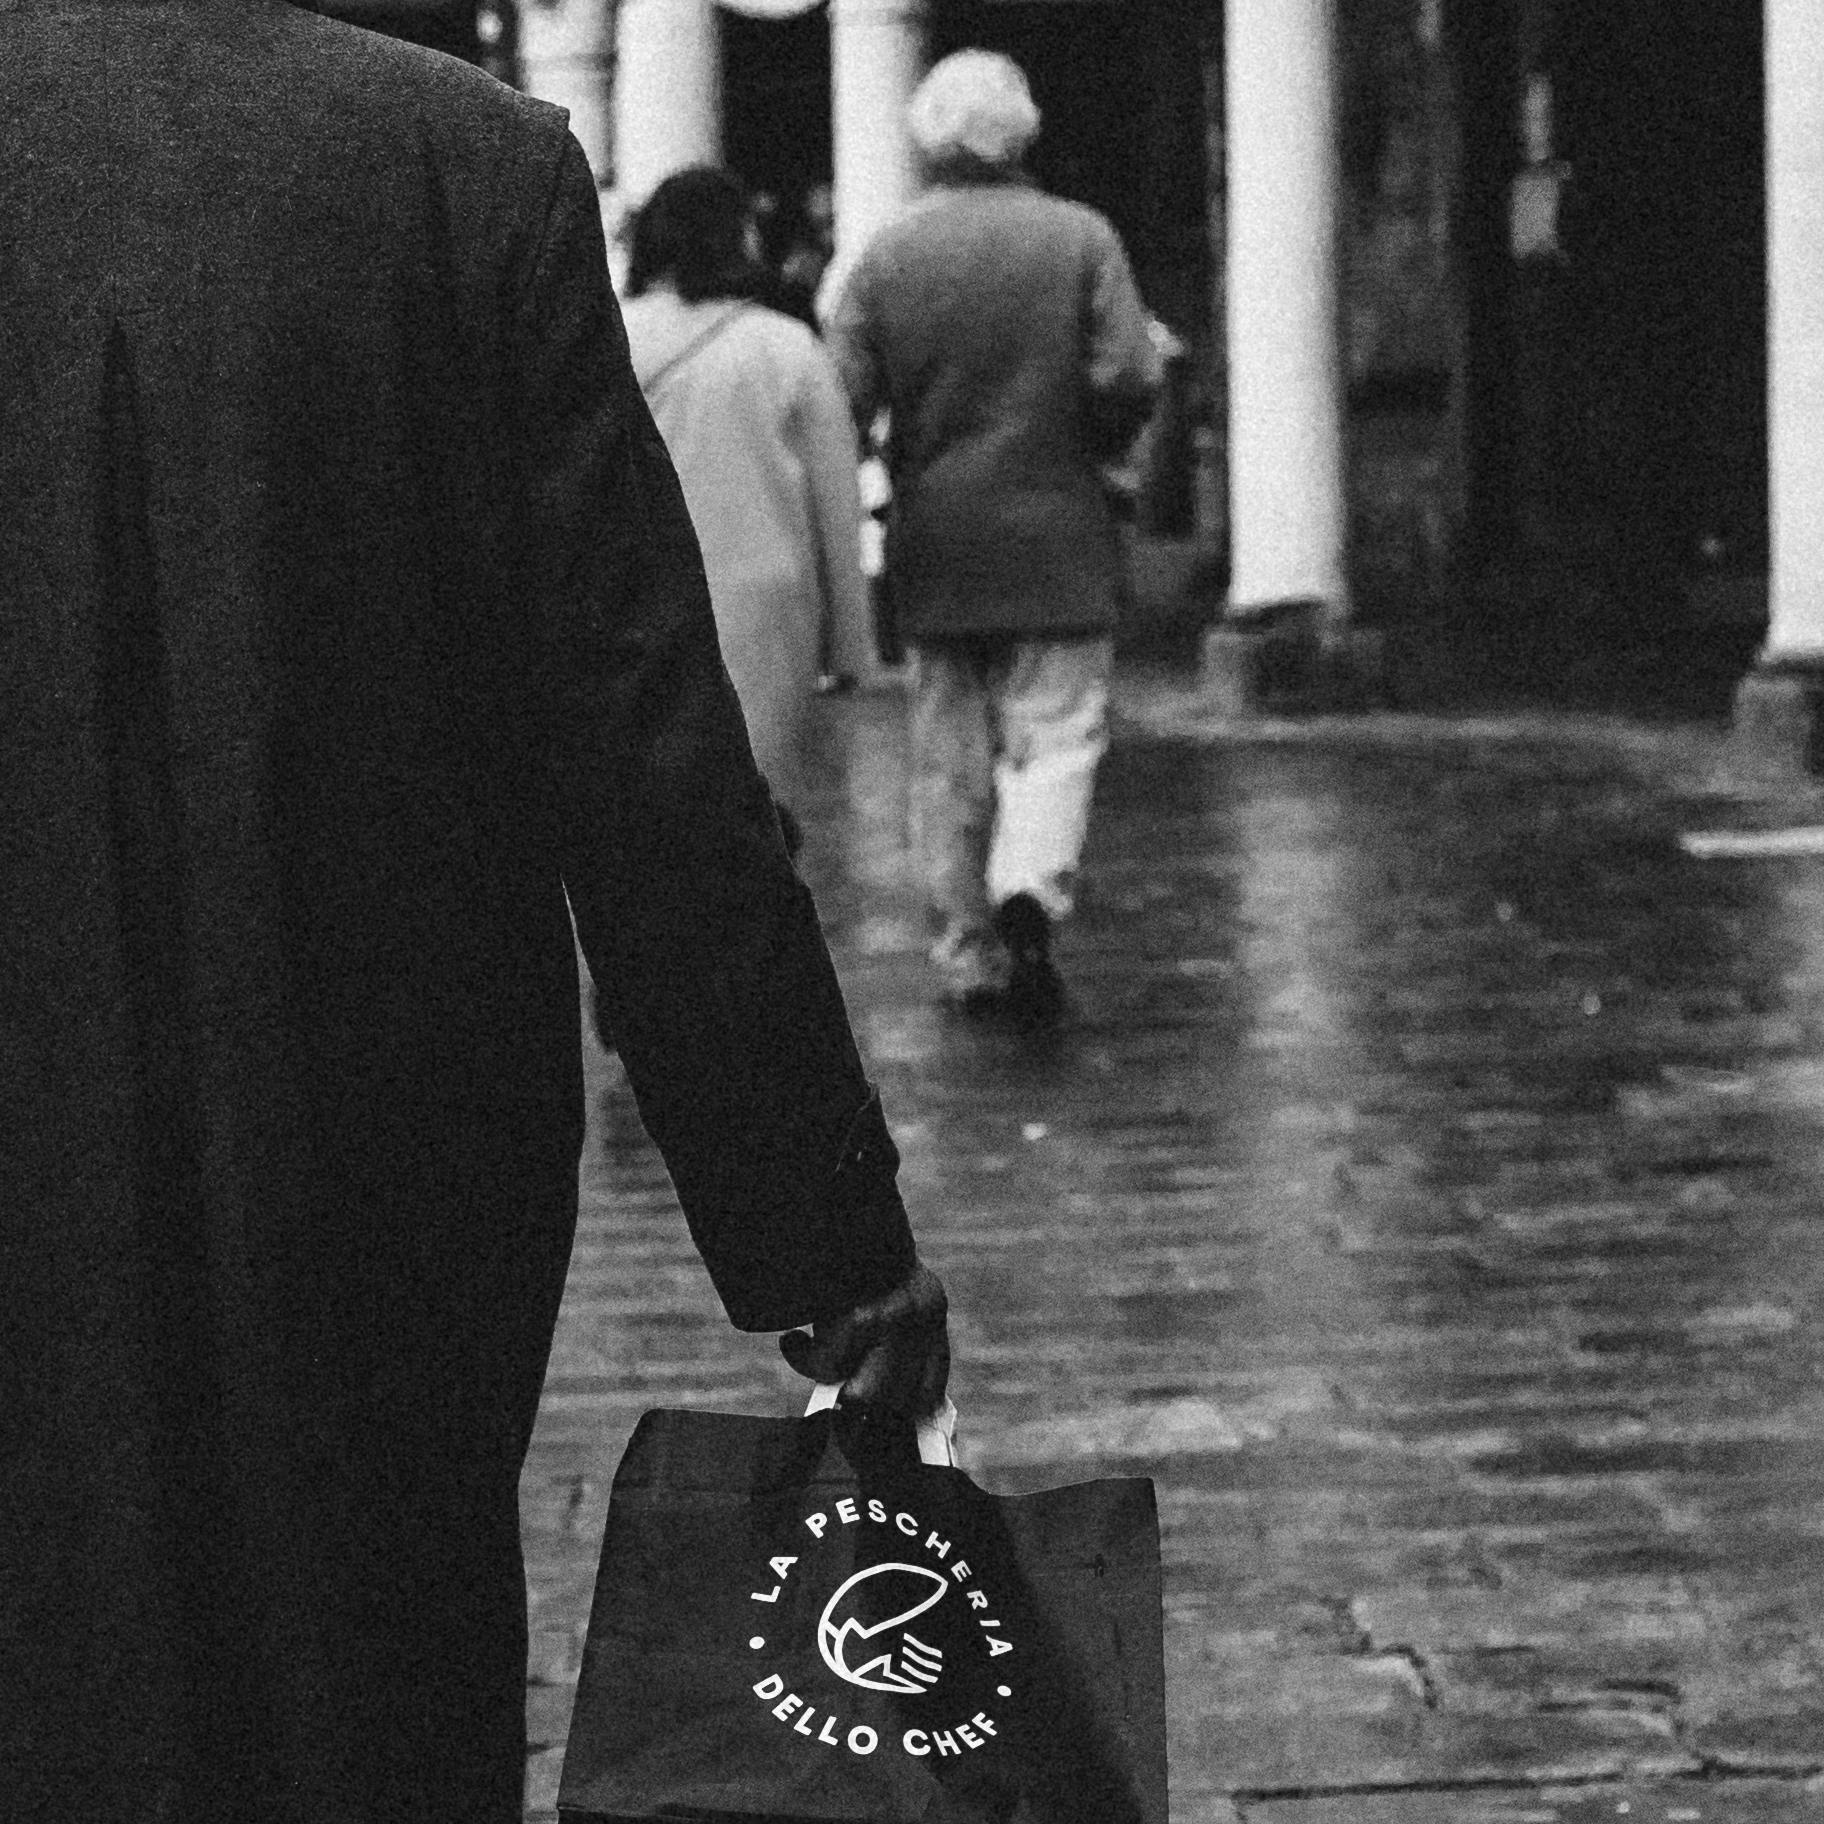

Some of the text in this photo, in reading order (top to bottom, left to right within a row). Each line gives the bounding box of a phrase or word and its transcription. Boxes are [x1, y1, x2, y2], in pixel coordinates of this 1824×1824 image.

[750, 1497, 1014, 1658] LA PESCHERIA
[752, 1673, 998, 1757] DELLO CHEF
